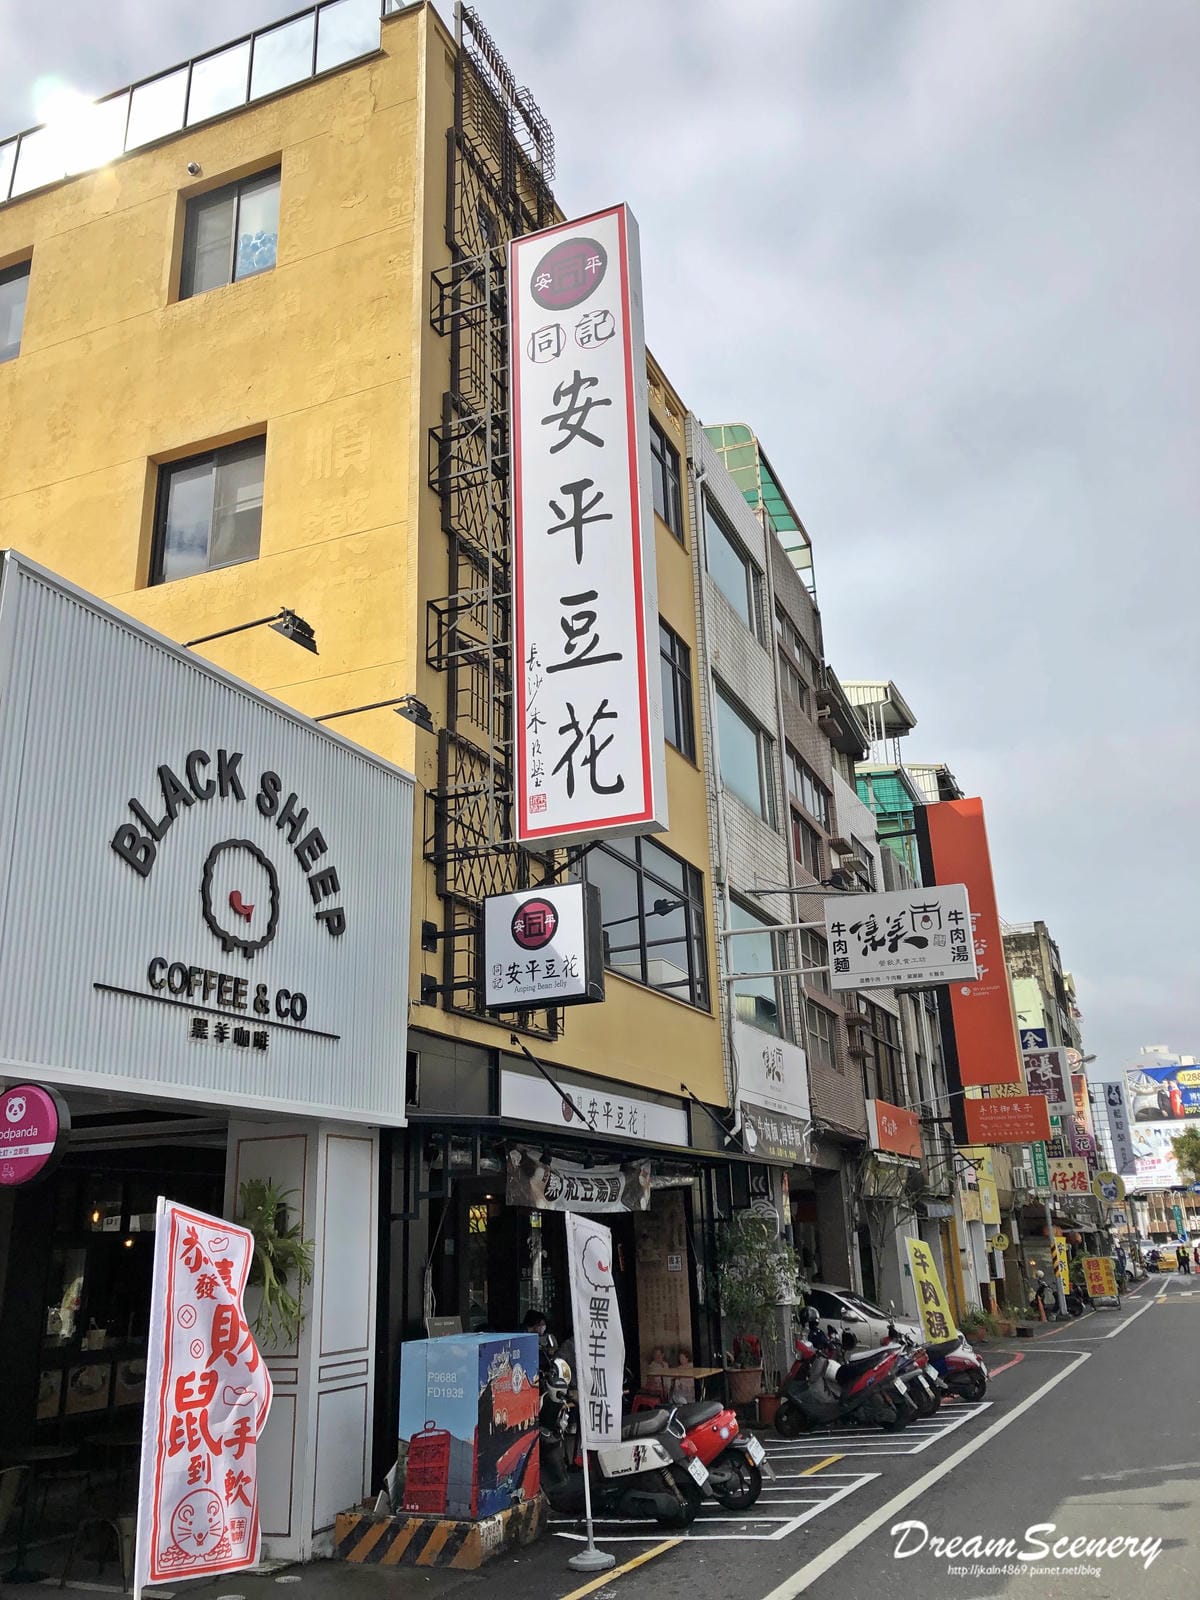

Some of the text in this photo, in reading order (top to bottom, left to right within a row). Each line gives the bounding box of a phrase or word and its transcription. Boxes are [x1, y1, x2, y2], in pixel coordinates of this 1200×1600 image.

[541, 369, 625, 799] 安平豆花
[111, 749, 346, 936] BLACK SHEEP
[830, 921, 850, 974] 牛肉麵
[947, 909, 969, 963] 牛肉湯
[148, 956, 308, 1022] COFFEE & CO
[505, 954, 579, 985] 安平豆花
[190, 1017, 270, 1051] 黑羊咖啡
[587, 1097, 638, 1135] 安平豆花
[913, 1247, 949, 1339] 牛肉湯
[428, 1371, 457, 1383] P9688
[588, 1296, 614, 1436] 黑羊咖啡
